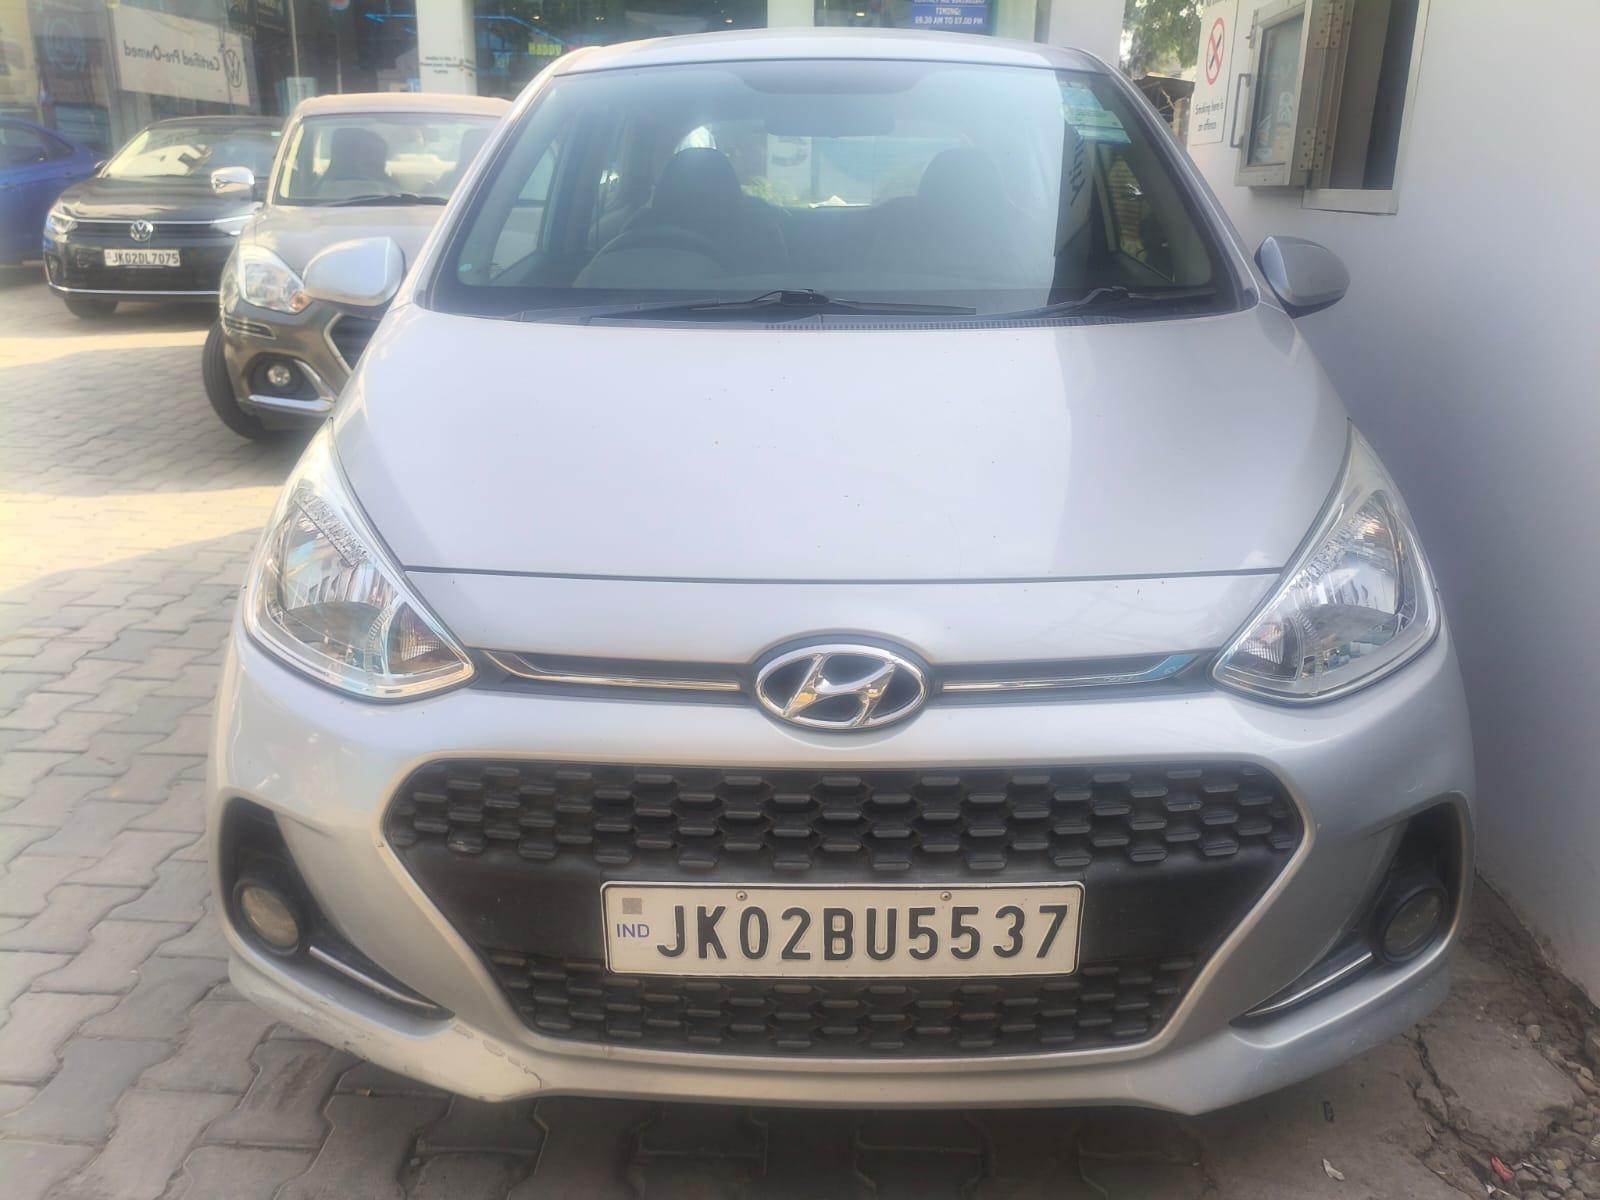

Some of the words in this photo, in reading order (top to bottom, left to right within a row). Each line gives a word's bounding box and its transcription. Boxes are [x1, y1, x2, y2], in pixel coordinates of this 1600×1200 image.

[933, 16, 943, 24] AM
[944, 16, 953, 24] TO
[112, 252, 179, 264] JK02DL7075
[616, 922, 650, 939] IND
[656, 904, 1069, 961] JK02BU5537
